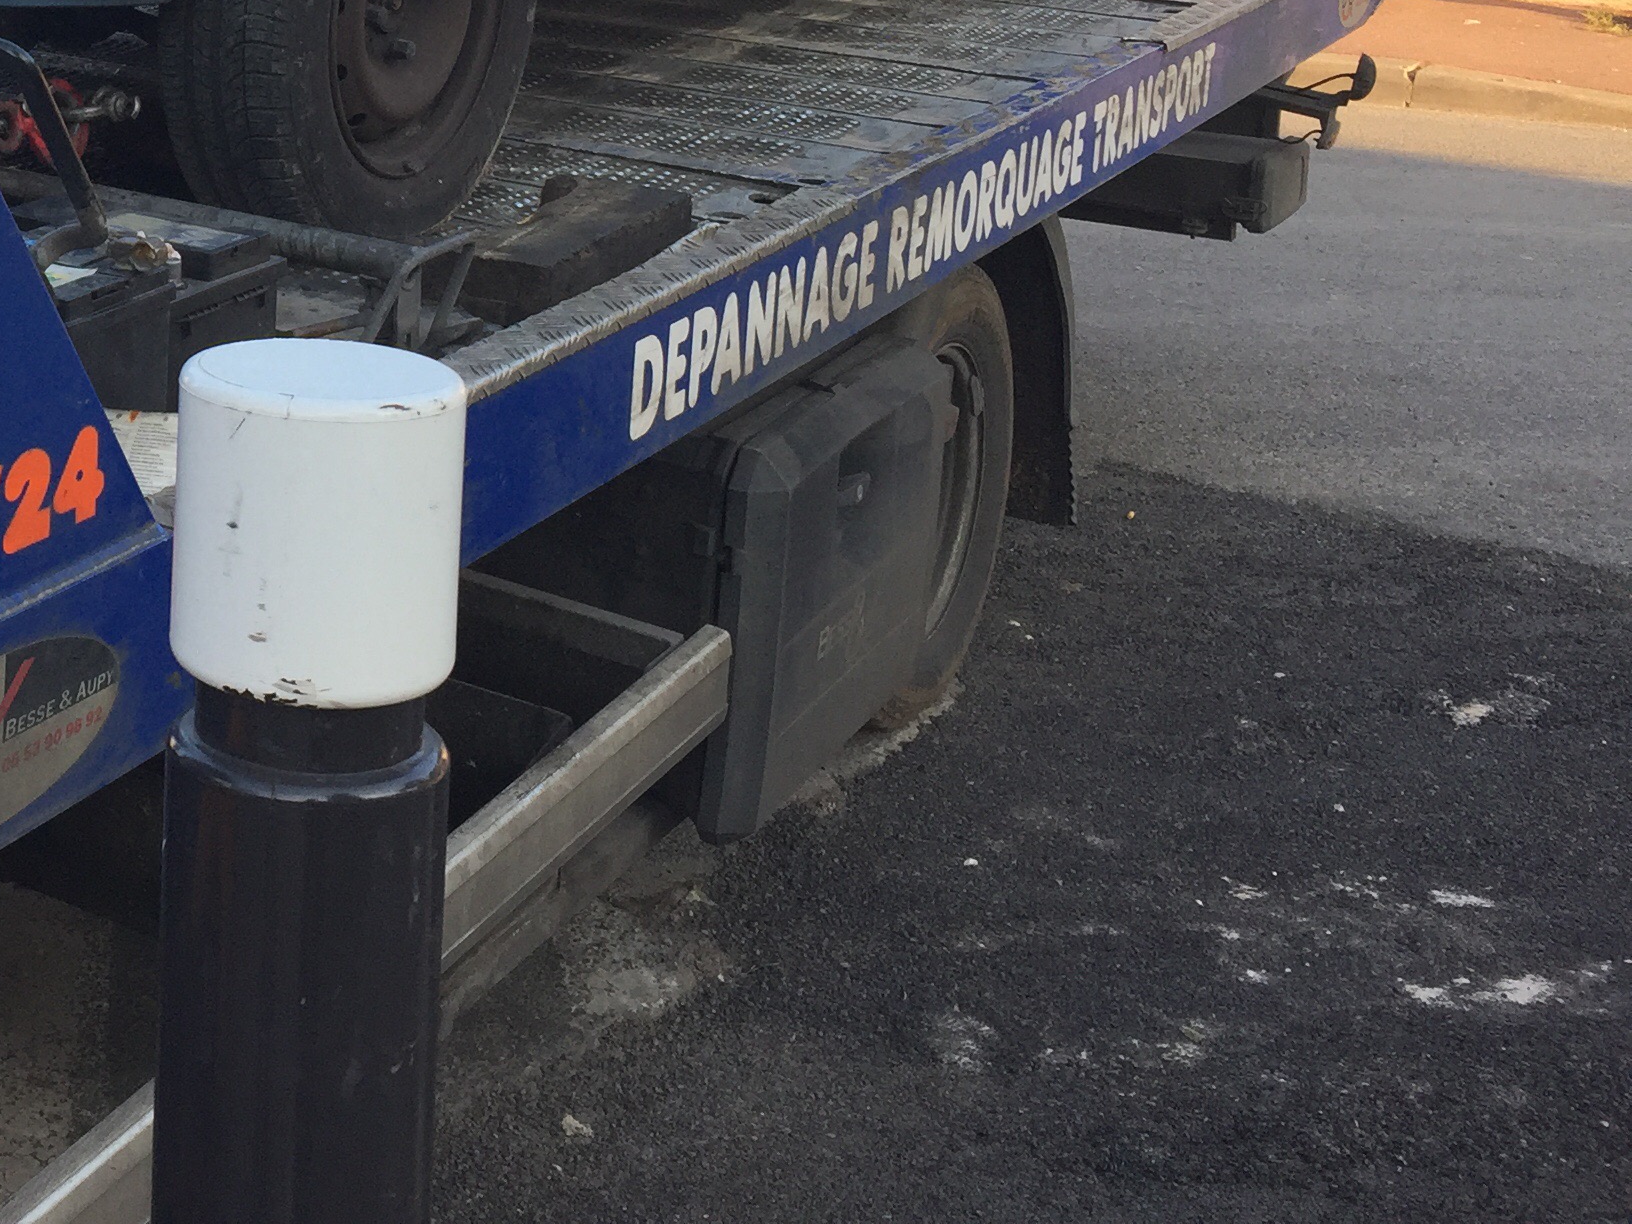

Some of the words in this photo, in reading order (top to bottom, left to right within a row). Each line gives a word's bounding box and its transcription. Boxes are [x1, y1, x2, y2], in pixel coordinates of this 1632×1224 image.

[629, 220, 877, 441] DEPANNAGE
[887, 111, 1085, 293] REMORQUAGE
[1092, 43, 1216, 174] TRANSPORT
[5, 699, 56, 740] BESSE
[59, 689, 73, 710] &
[76, 670, 114, 702] AUPY
